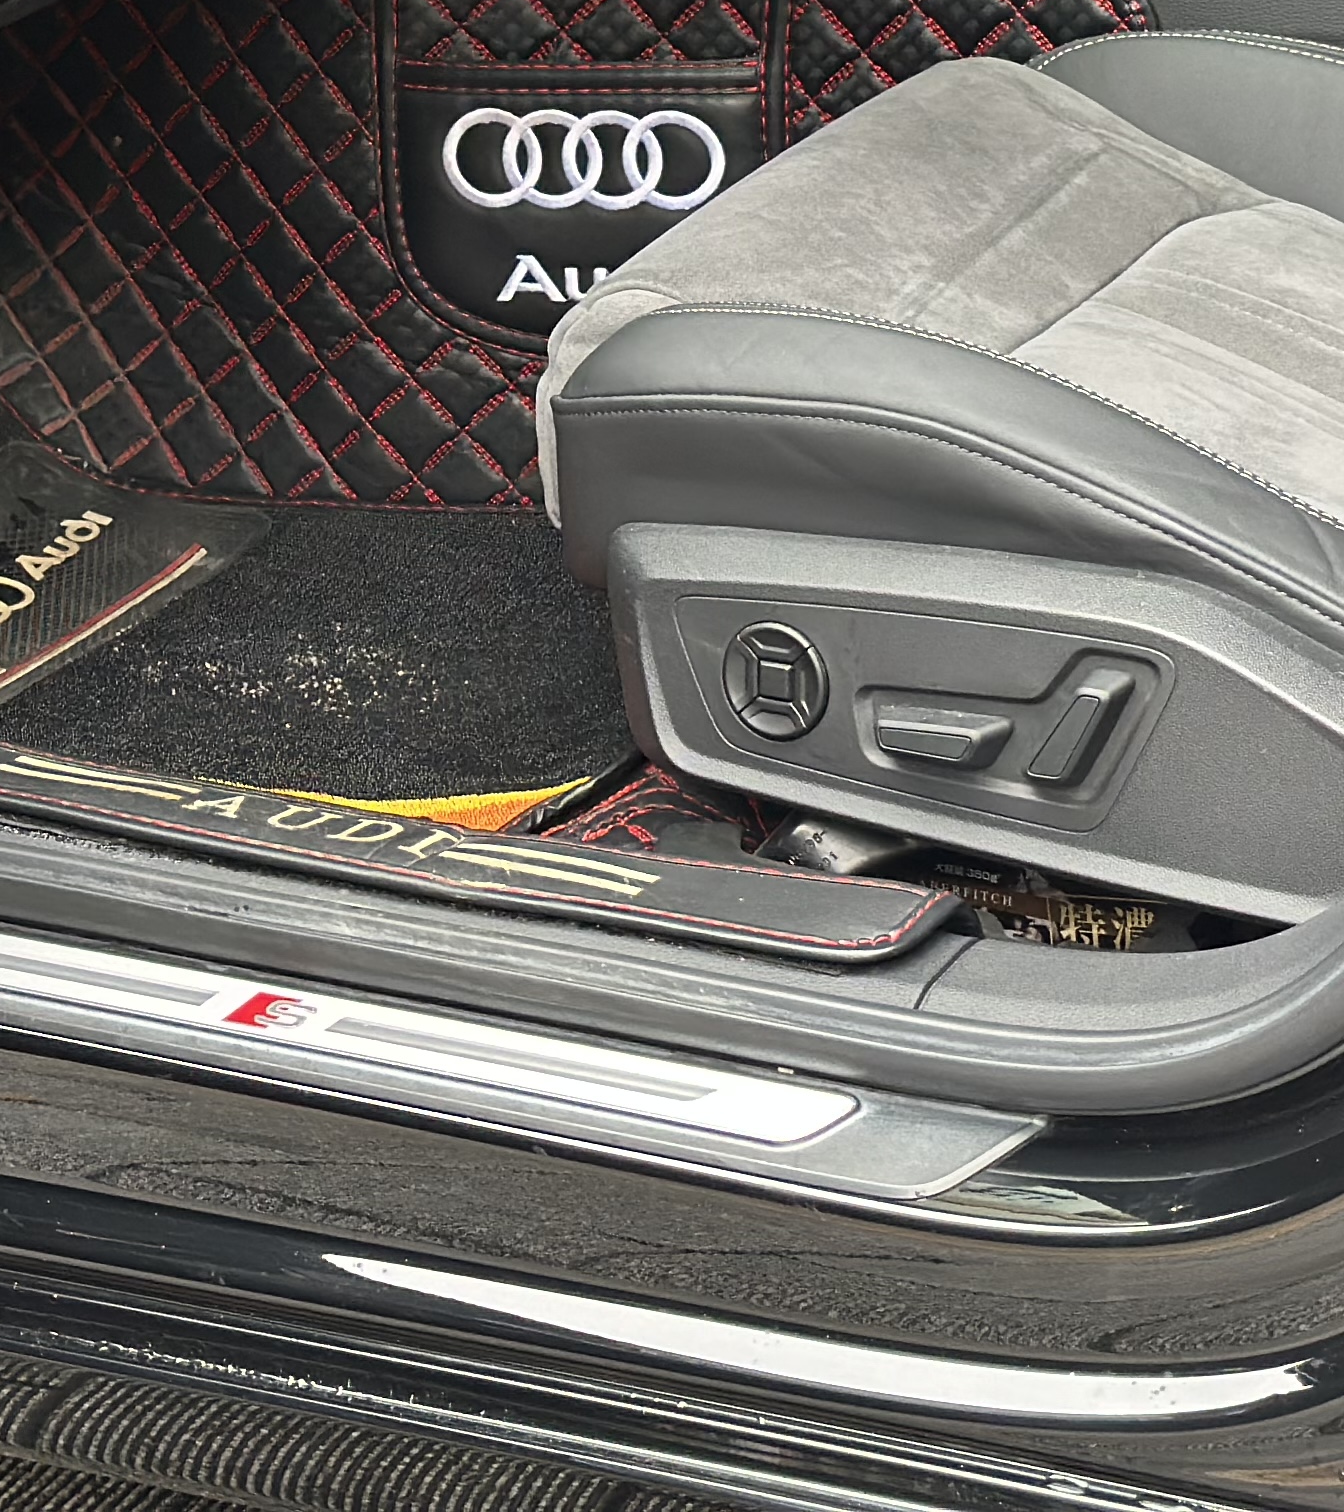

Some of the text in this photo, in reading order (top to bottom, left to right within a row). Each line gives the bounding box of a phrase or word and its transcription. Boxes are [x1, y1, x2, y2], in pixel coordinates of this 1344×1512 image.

[496, 253, 609, 302] Au
[15, 510, 113, 581] Audi
[181, 795, 461, 859] AUDI
